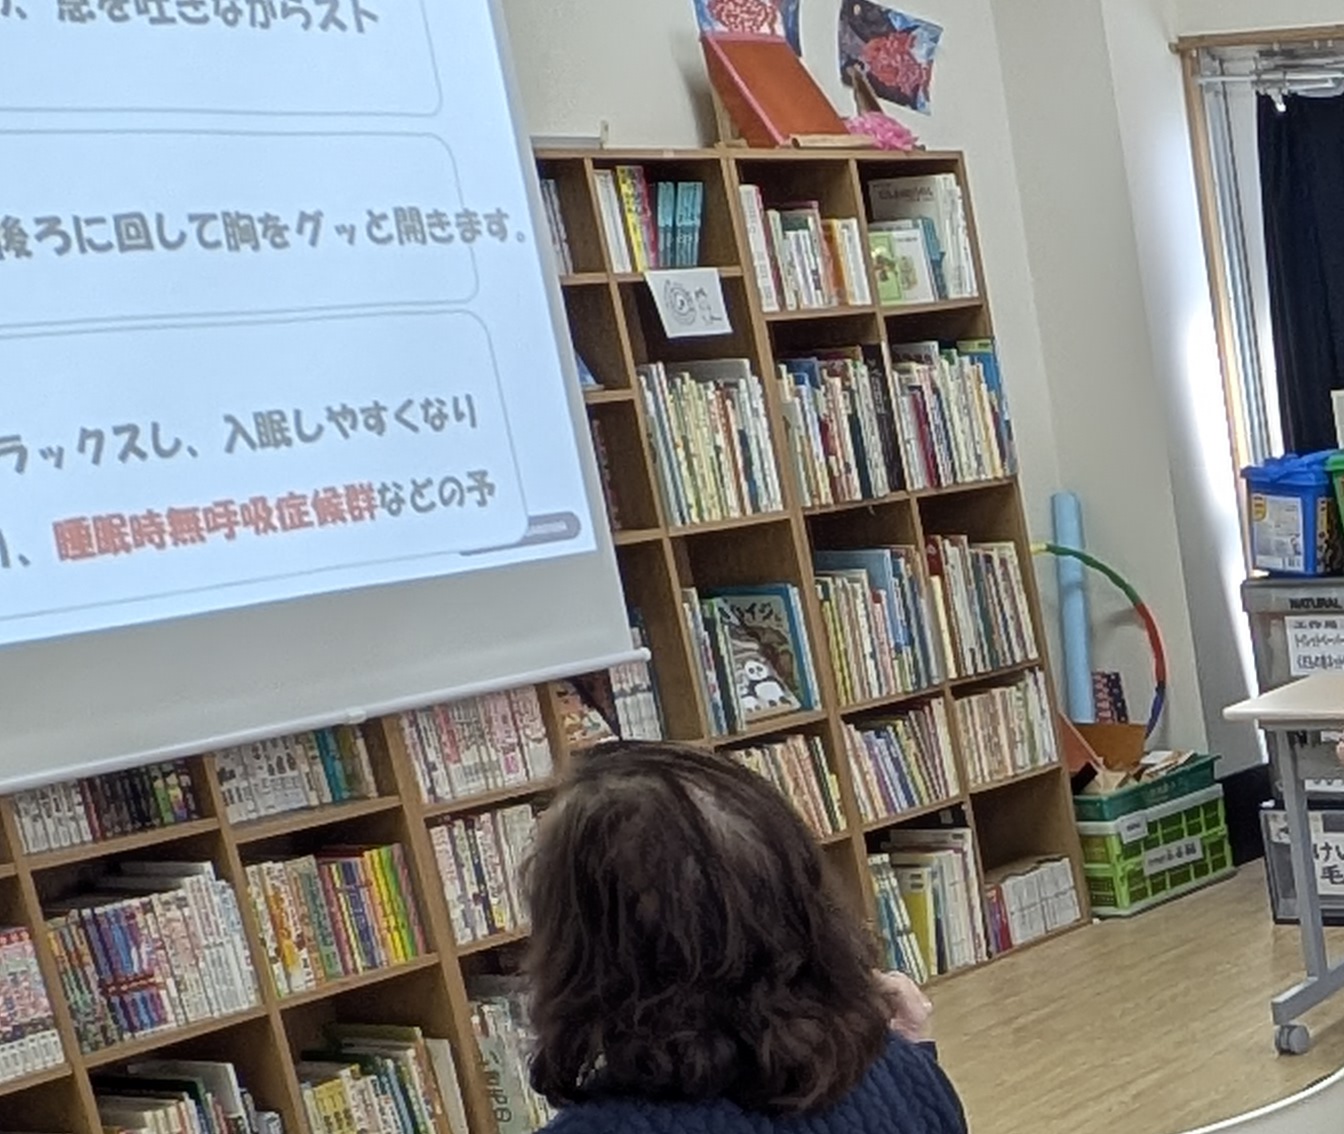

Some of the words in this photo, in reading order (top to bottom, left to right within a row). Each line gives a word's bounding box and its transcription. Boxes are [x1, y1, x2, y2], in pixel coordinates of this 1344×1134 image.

[0, 206, 527, 260] 後ろに回して胸をグッと開きます。
[0, 393, 479, 474] ラックスし、入眠しやすくなり
[1289, 597, 1343, 610] NATURAL
